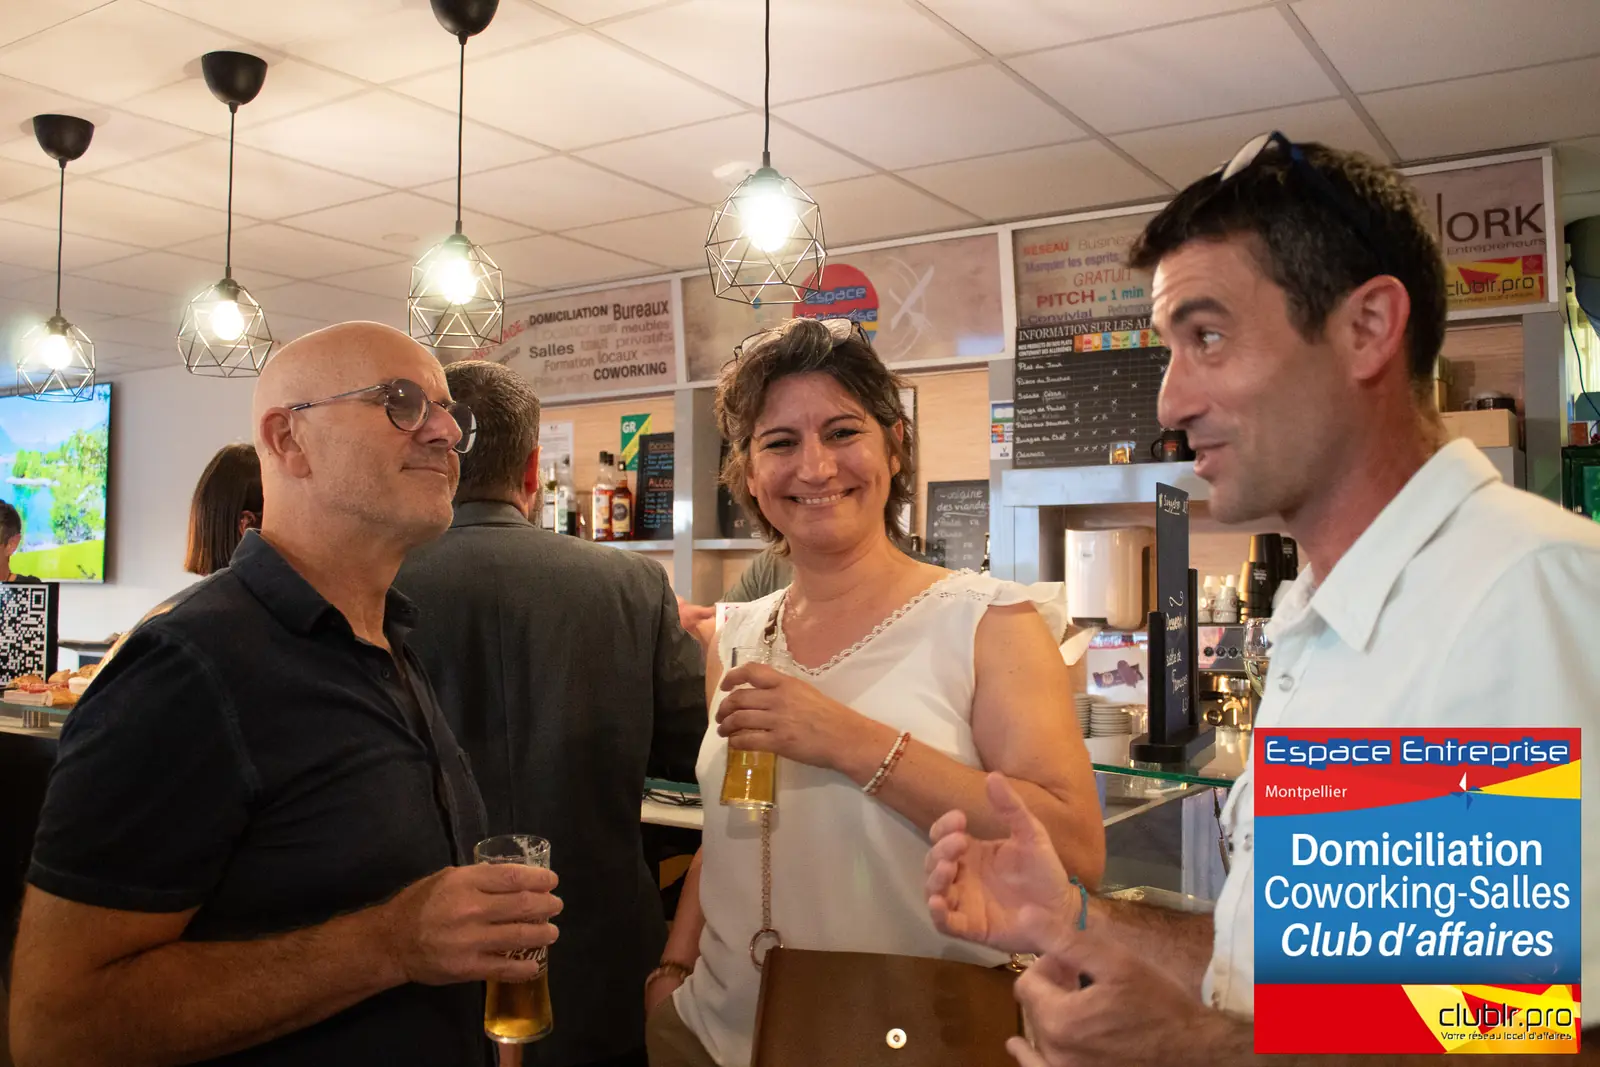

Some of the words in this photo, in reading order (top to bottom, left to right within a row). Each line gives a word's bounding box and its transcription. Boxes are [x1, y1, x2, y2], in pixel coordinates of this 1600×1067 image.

[1073, 267, 1133, 288] GRATUIT
[1036, 288, 1096, 309] PITCH
[1121, 287, 1144, 300] min
[529, 304, 608, 326] DOMICILIATION
[613, 300, 669, 322] Bureaux
[1019, 324, 1089, 342] INFORMATION
[1090, 320, 1112, 334] SUR
[1114, 318, 1134, 331] LES
[529, 343, 574, 360] Salles
[597, 349, 639, 365] locaux
[593, 361, 667, 381] COWORKING
[622, 421, 637, 434] GR
